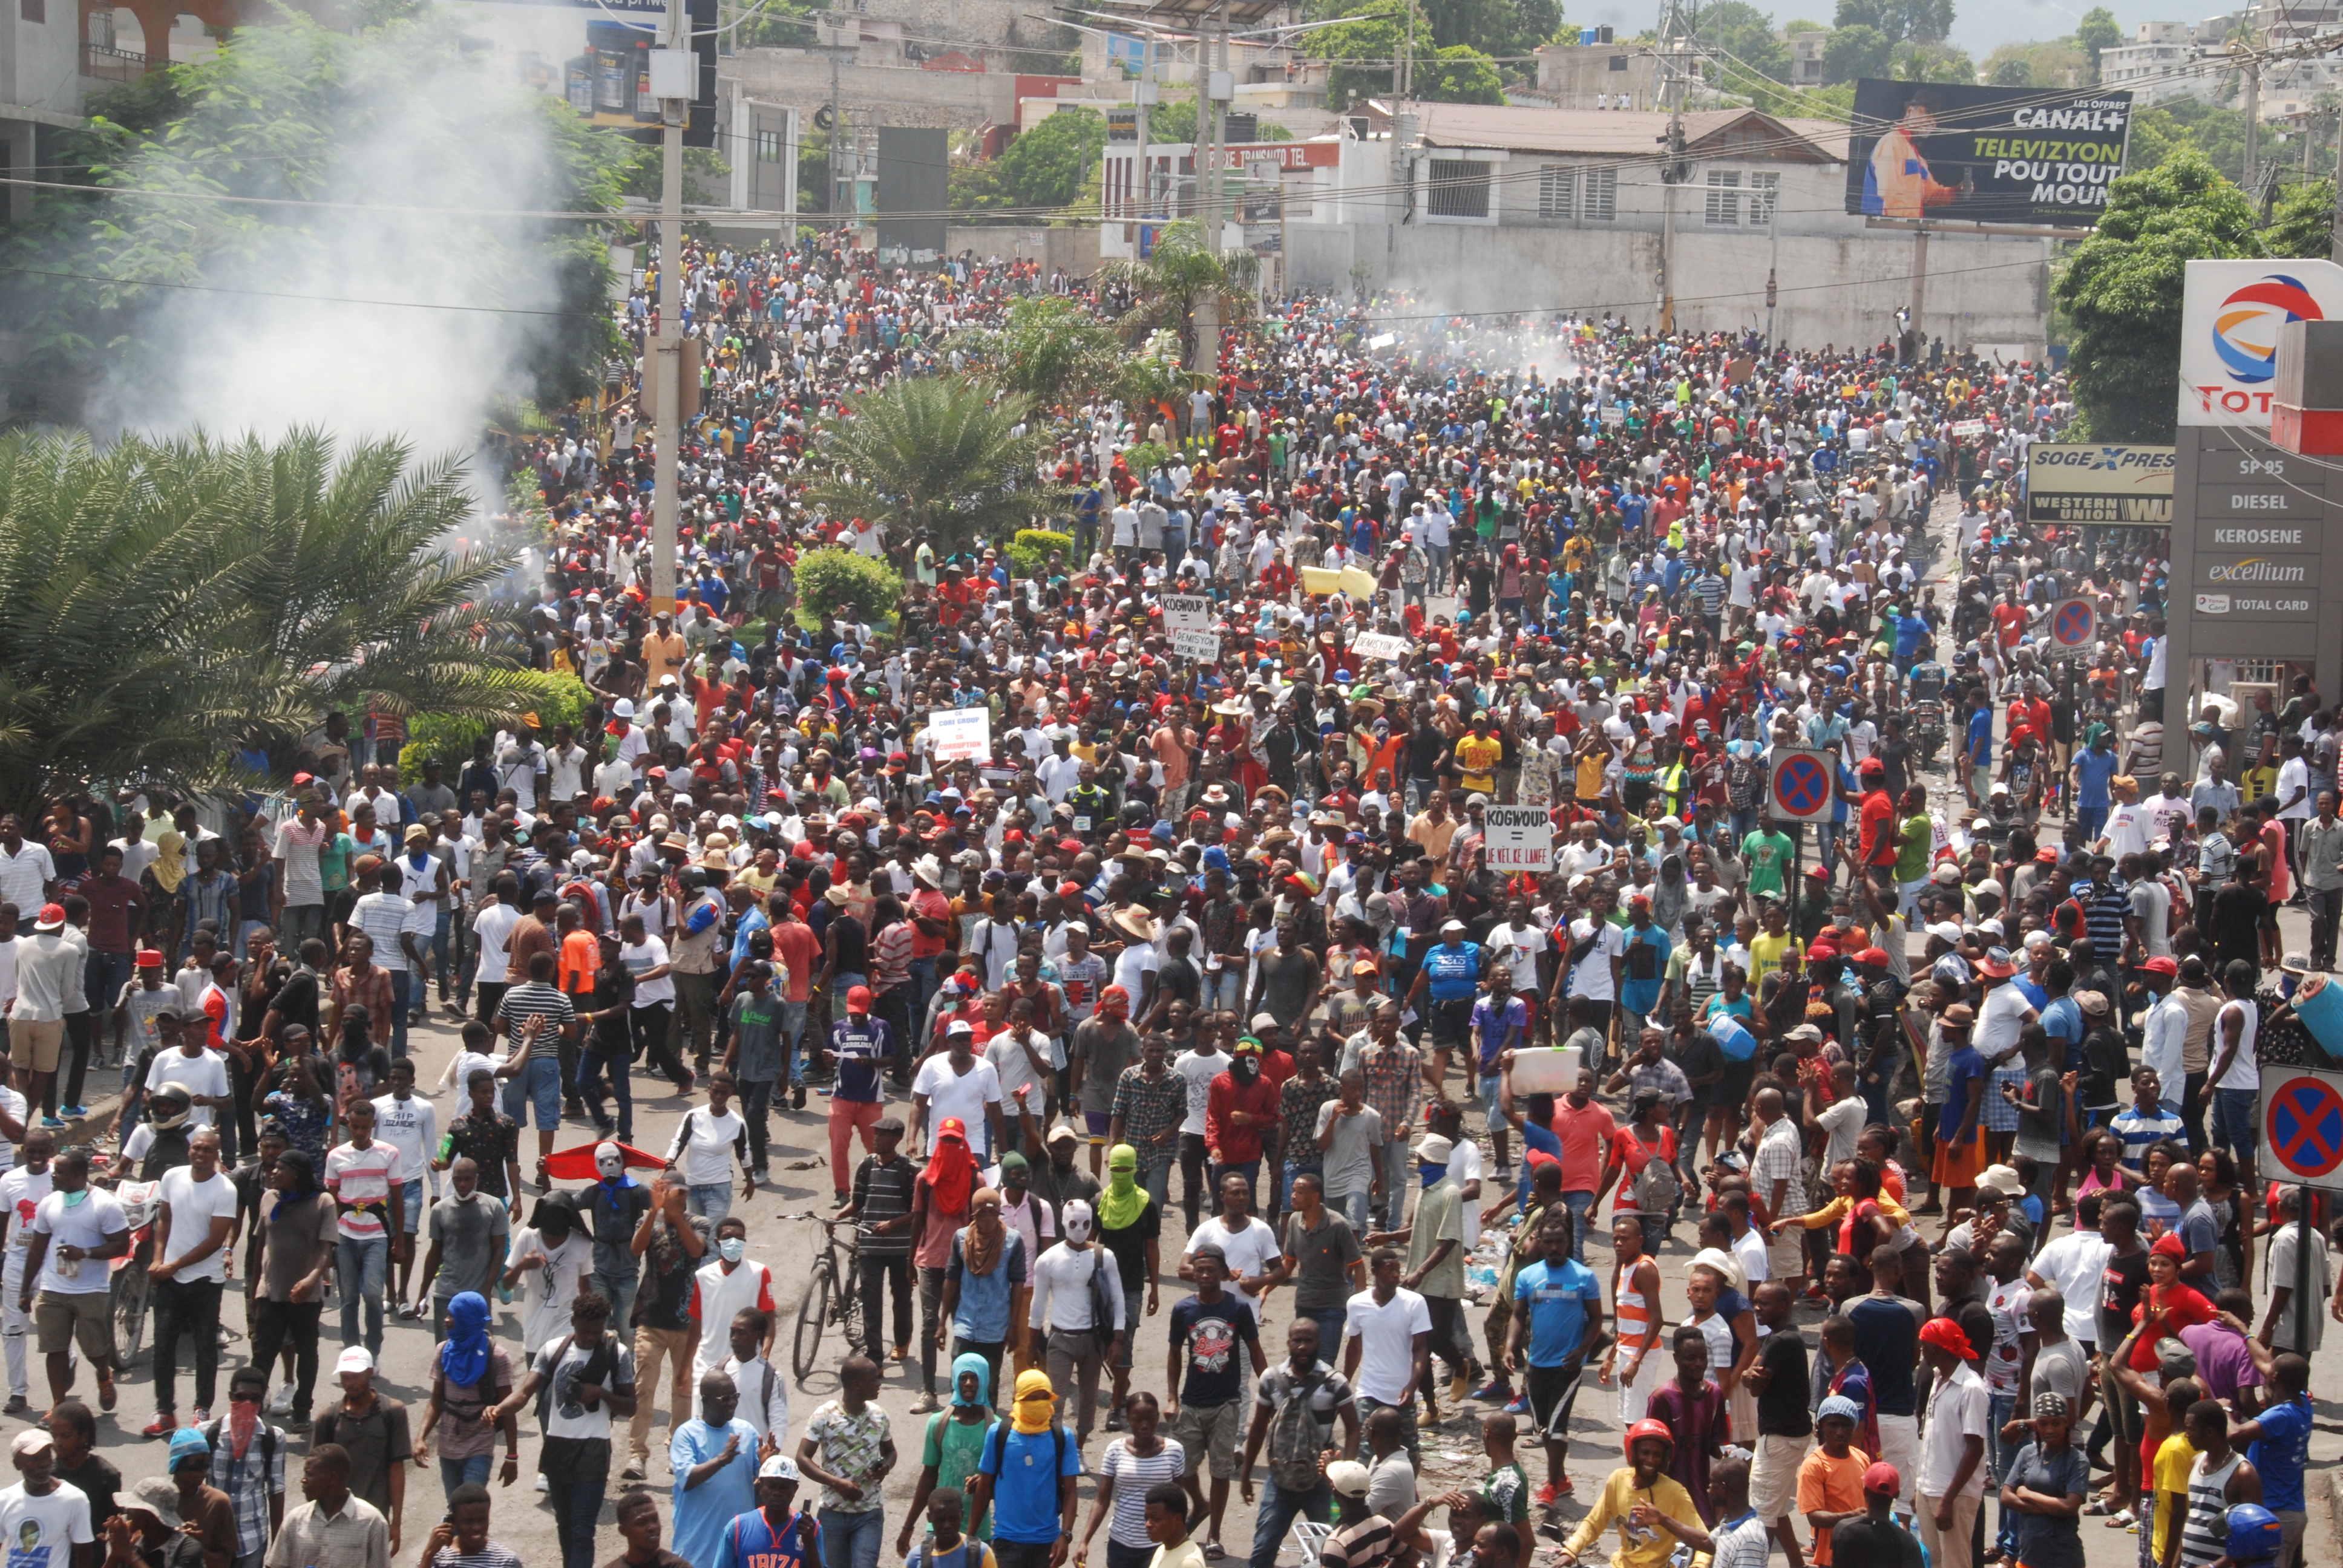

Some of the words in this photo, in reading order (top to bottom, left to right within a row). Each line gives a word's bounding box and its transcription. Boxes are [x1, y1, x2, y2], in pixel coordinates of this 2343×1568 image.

[2074, 99, 2088, 108] LES
[2091, 100, 2126, 109] OFFRES
[2013, 108, 2124, 132] CANAL+
[1974, 137, 2122, 163] TELEVIZYON
[1994, 160, 2050, 180] POU
[2056, 162, 2122, 184] TOUT
[2030, 183, 2113, 206] MOUN
[2240, 460, 2260, 474] SP
[2265, 460, 2284, 474] 95
[2034, 497, 2117, 509] WESTERN
[2231, 495, 2288, 509] DIESEL
[2060, 508, 2117, 520] UNION
[2215, 529, 2302, 544] KEROSENE
[2209, 563, 2305, 581] excellium
[2235, 599, 2272, 610] TOTAL
[2275, 599, 2309, 612] CARD
[1176, 632, 1216, 646] DEMISYON
[1355, 648, 1395, 659] JOVENEL
[939, 741, 981, 751] CORRUPTION
[1487, 806, 1548, 827] KÒGWOUP
[842, 1042, 873, 1050] CAROLINA
